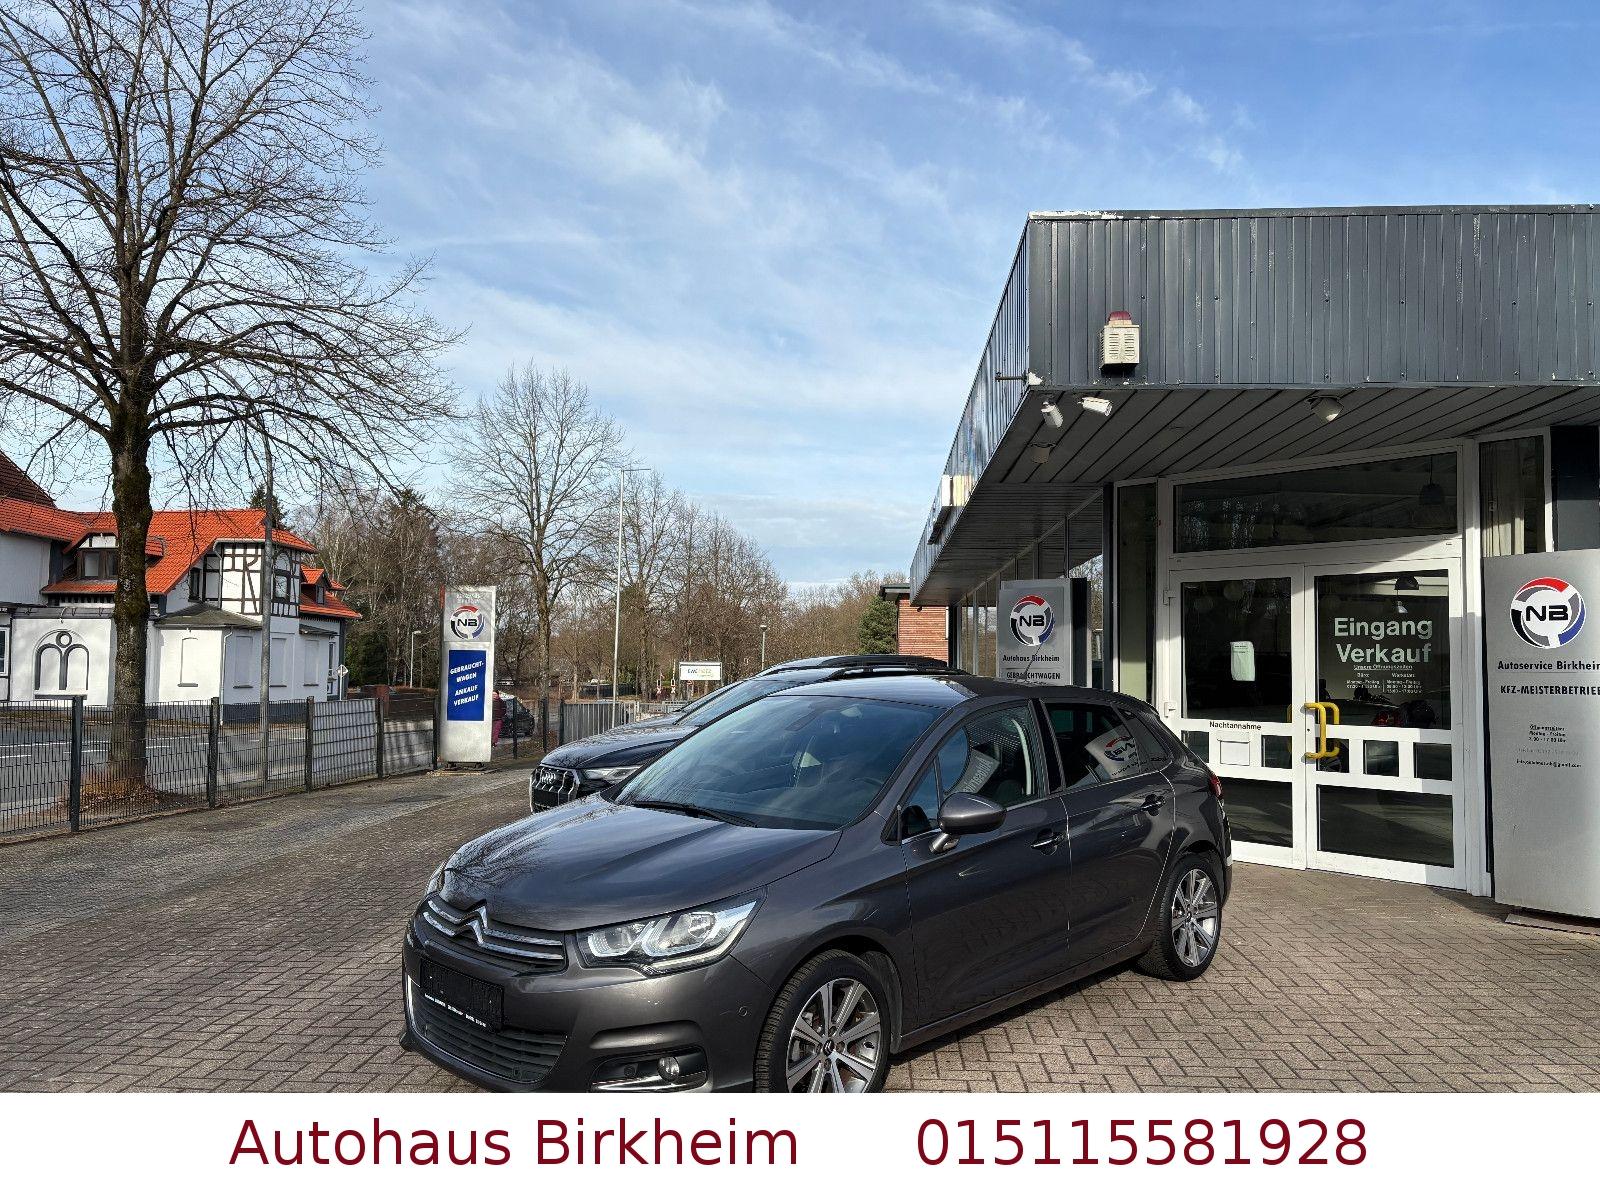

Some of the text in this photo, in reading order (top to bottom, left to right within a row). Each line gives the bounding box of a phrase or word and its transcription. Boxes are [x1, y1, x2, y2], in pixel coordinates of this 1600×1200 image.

[1525, 604, 1569, 622] NB
[457, 618, 478, 627] NB
[1019, 614, 1046, 627] NB
[1334, 617, 1433, 641] Eingang
[1002, 654, 1060, 662] Autohaus Birkheim
[1336, 642, 1432, 663] Verkauf
[1497, 660, 1553, 671] Autoservice
[456, 671, 477, 683] WAGEN
[454, 684, 478, 697] ANKAUF
[453, 693, 479, 707] VERKAUF
[1209, 720, 1262, 731] Nachtannahme
